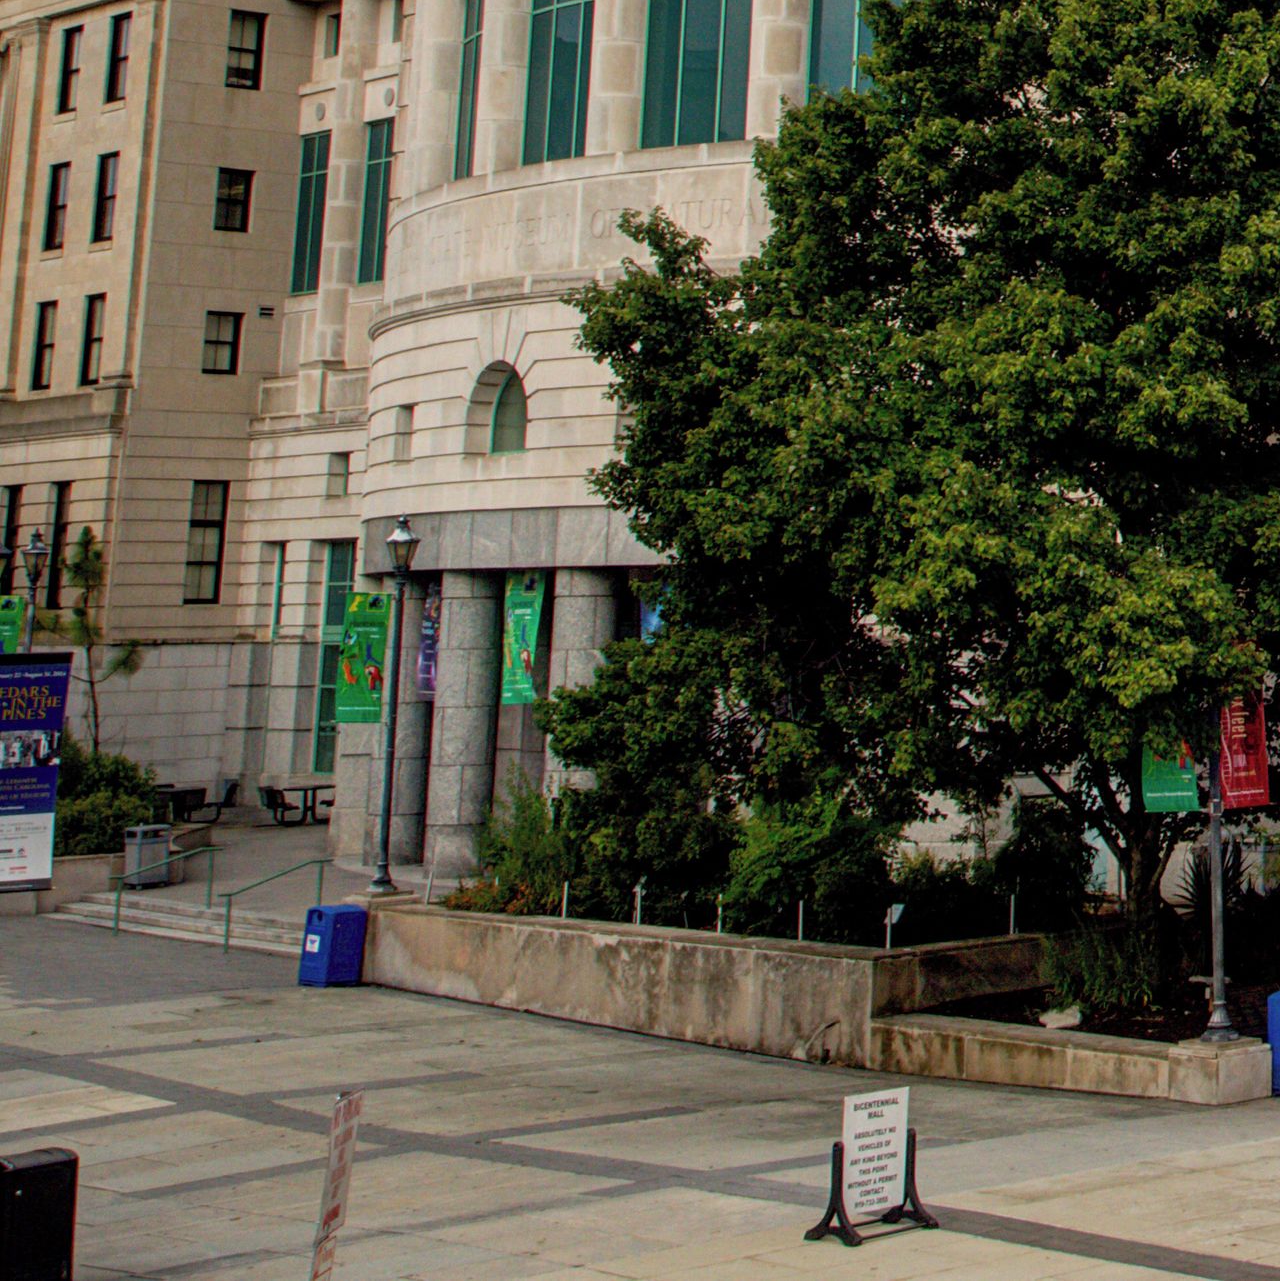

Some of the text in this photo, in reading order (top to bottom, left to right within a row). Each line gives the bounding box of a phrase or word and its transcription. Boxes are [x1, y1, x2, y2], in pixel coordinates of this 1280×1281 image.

[33, 696, 62, 709] THE
[2, 708, 47, 720] PINES
[853, 1097, 899, 1112] BICENTENNIAL
[867, 1110, 884, 1119] MALL
[854, 1126, 897, 1140] ABSOLUTELY NO
[858, 1139, 892, 1152] VEHICLES OF
[850, 1151, 898, 1166] ANY KIND BEYOND
[859, 1164, 888, 1175] THIS POINT
[847, 1178, 872, 1189] WITHOUT
[878, 1174, 898, 1184] PERMIT
[859, 1186, 885, 1198] CONTACT
